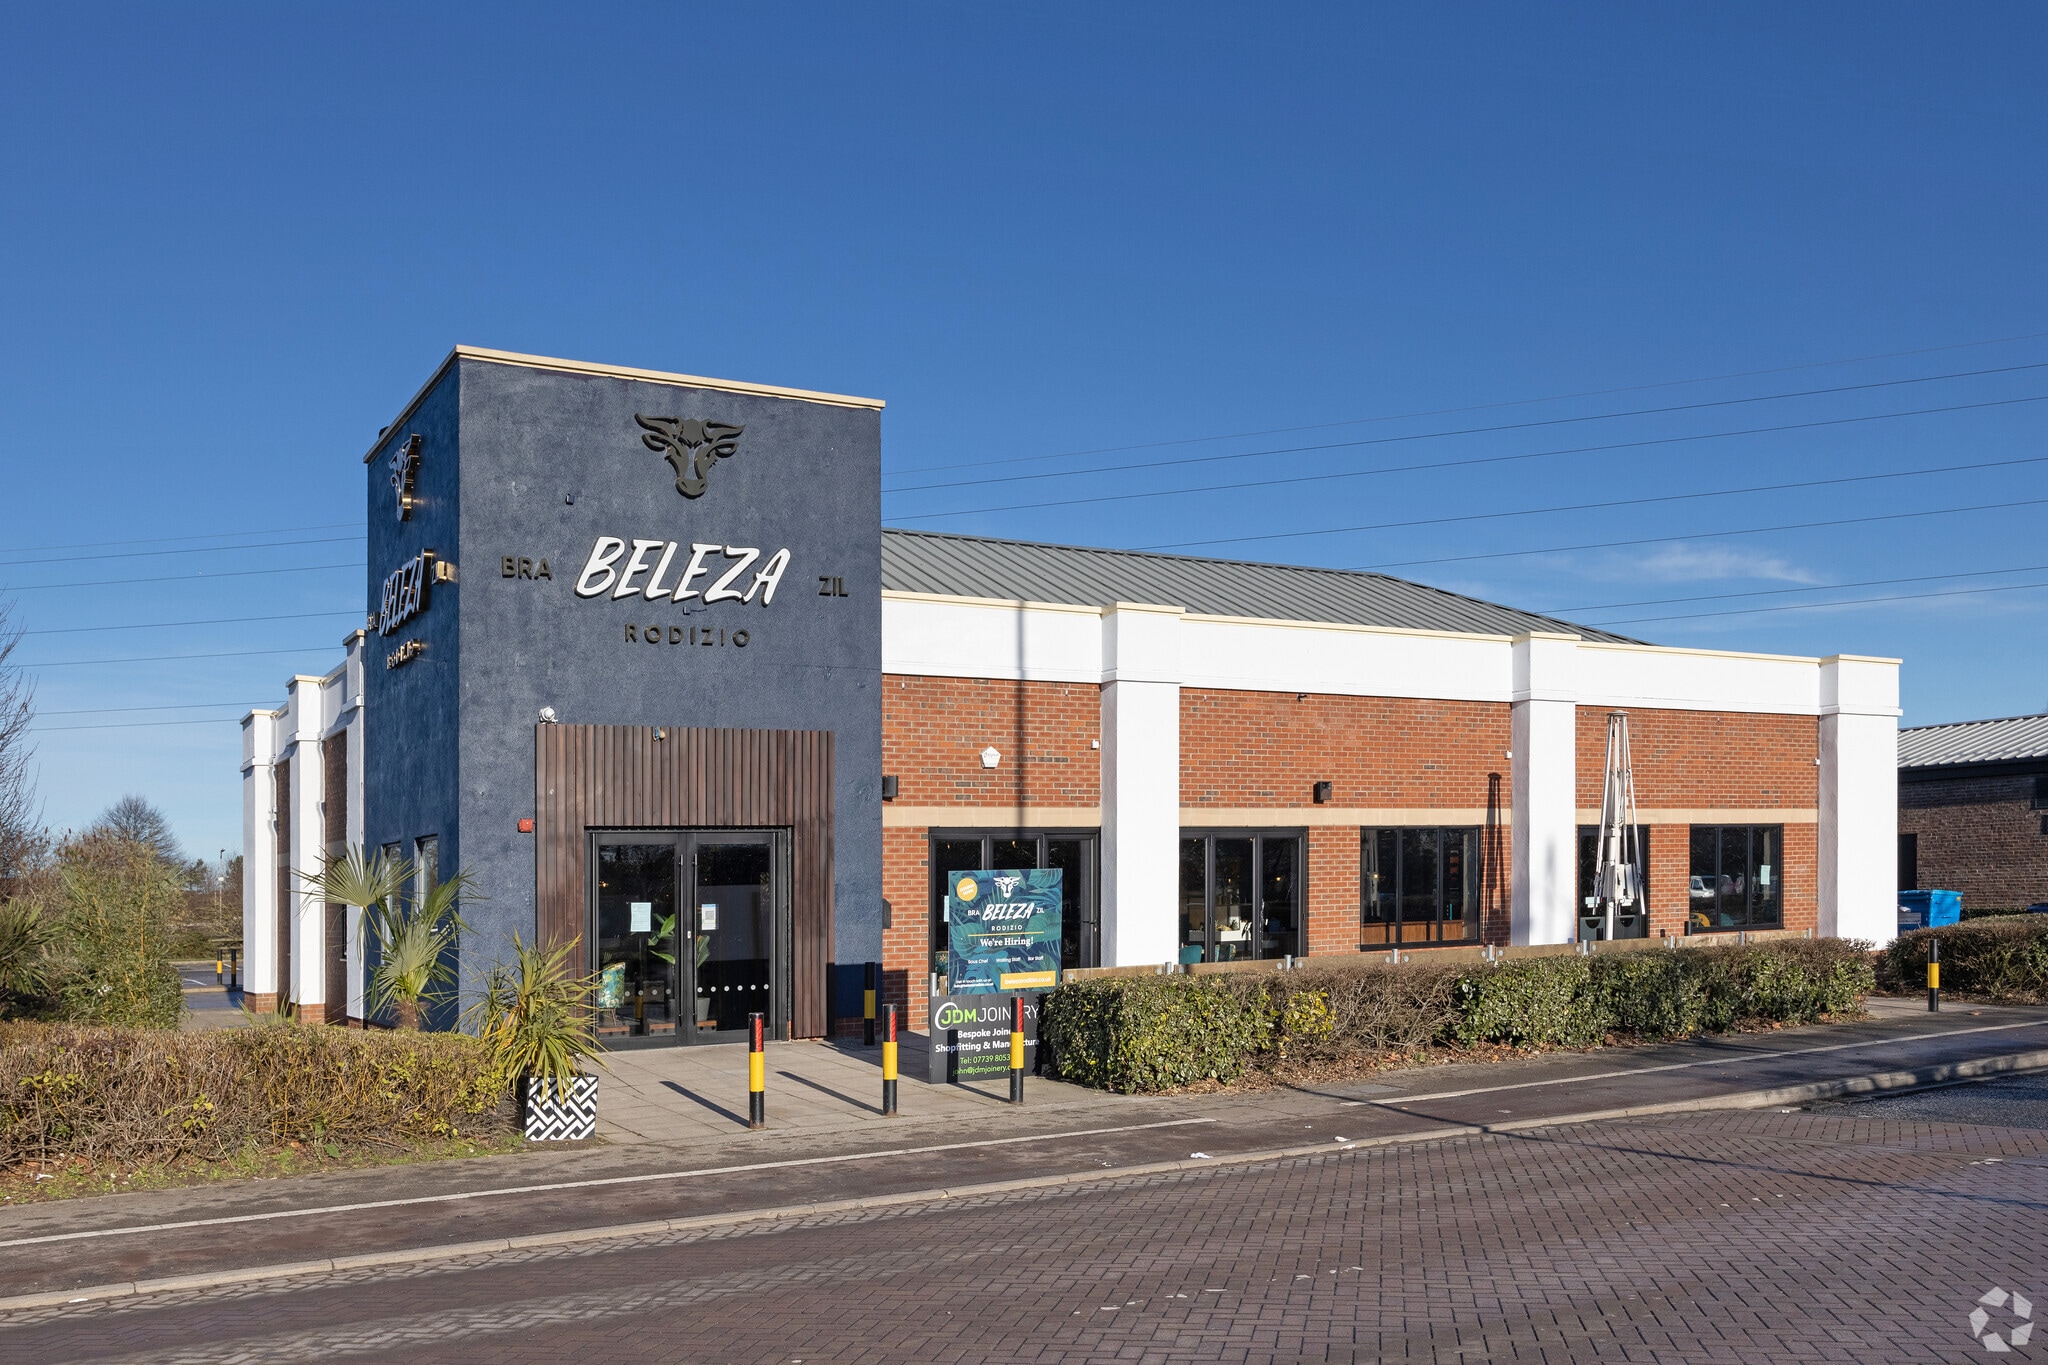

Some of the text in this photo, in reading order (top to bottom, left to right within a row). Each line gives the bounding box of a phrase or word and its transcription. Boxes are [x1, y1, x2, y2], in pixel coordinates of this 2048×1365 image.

[501, 536, 849, 607] BRA BELEZA ZIL
[624, 622, 751, 648] RODIZIO
[982, 902, 1035, 921] BELEZA
[980, 936, 1034, 947] We're Hiring!
[941, 1004, 1040, 1025] JDM JOINRY
[957, 1027, 1011, 1040] Bespoke Join
[935, 1042, 981, 1053] Shopfitting
[983, 1041, 991, 1050] &
[960, 1053, 1011, 1065] Tel: 07739 8053
